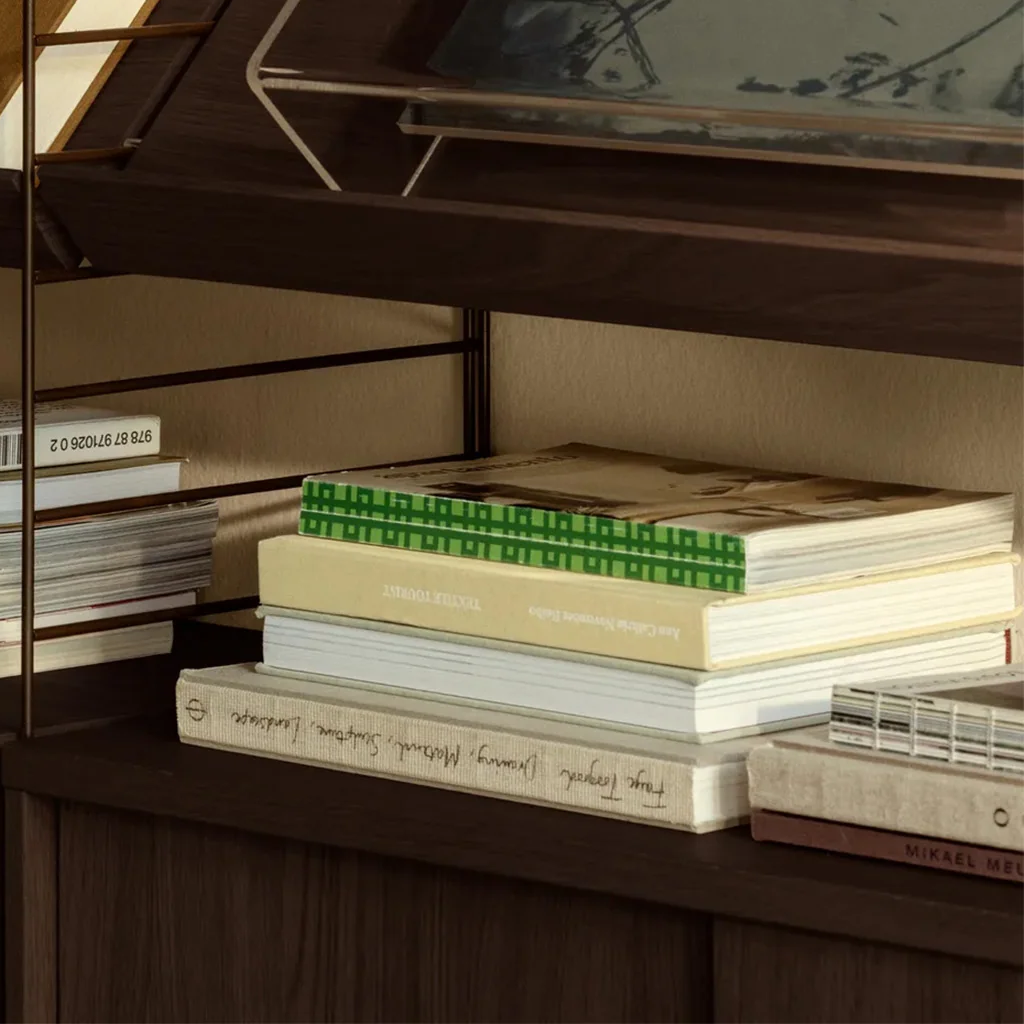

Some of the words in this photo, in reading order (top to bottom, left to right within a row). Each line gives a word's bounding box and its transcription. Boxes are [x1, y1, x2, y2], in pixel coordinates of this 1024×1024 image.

[49, 438, 59, 452] 2
[60, 437, 69, 451] 0
[70, 433, 113, 450] 971026
[114, 431, 129, 447] 87
[130, 429, 153, 444] 978
[382, 585, 431, 608] TOURIST
[432, 592, 482, 612] TEXTILE
[657, 626, 681, 641] Ann
[230, 711, 302, 746] Landscape
[626, 769, 667, 809] Faye
[904, 843, 977, 869] MIKAEL
